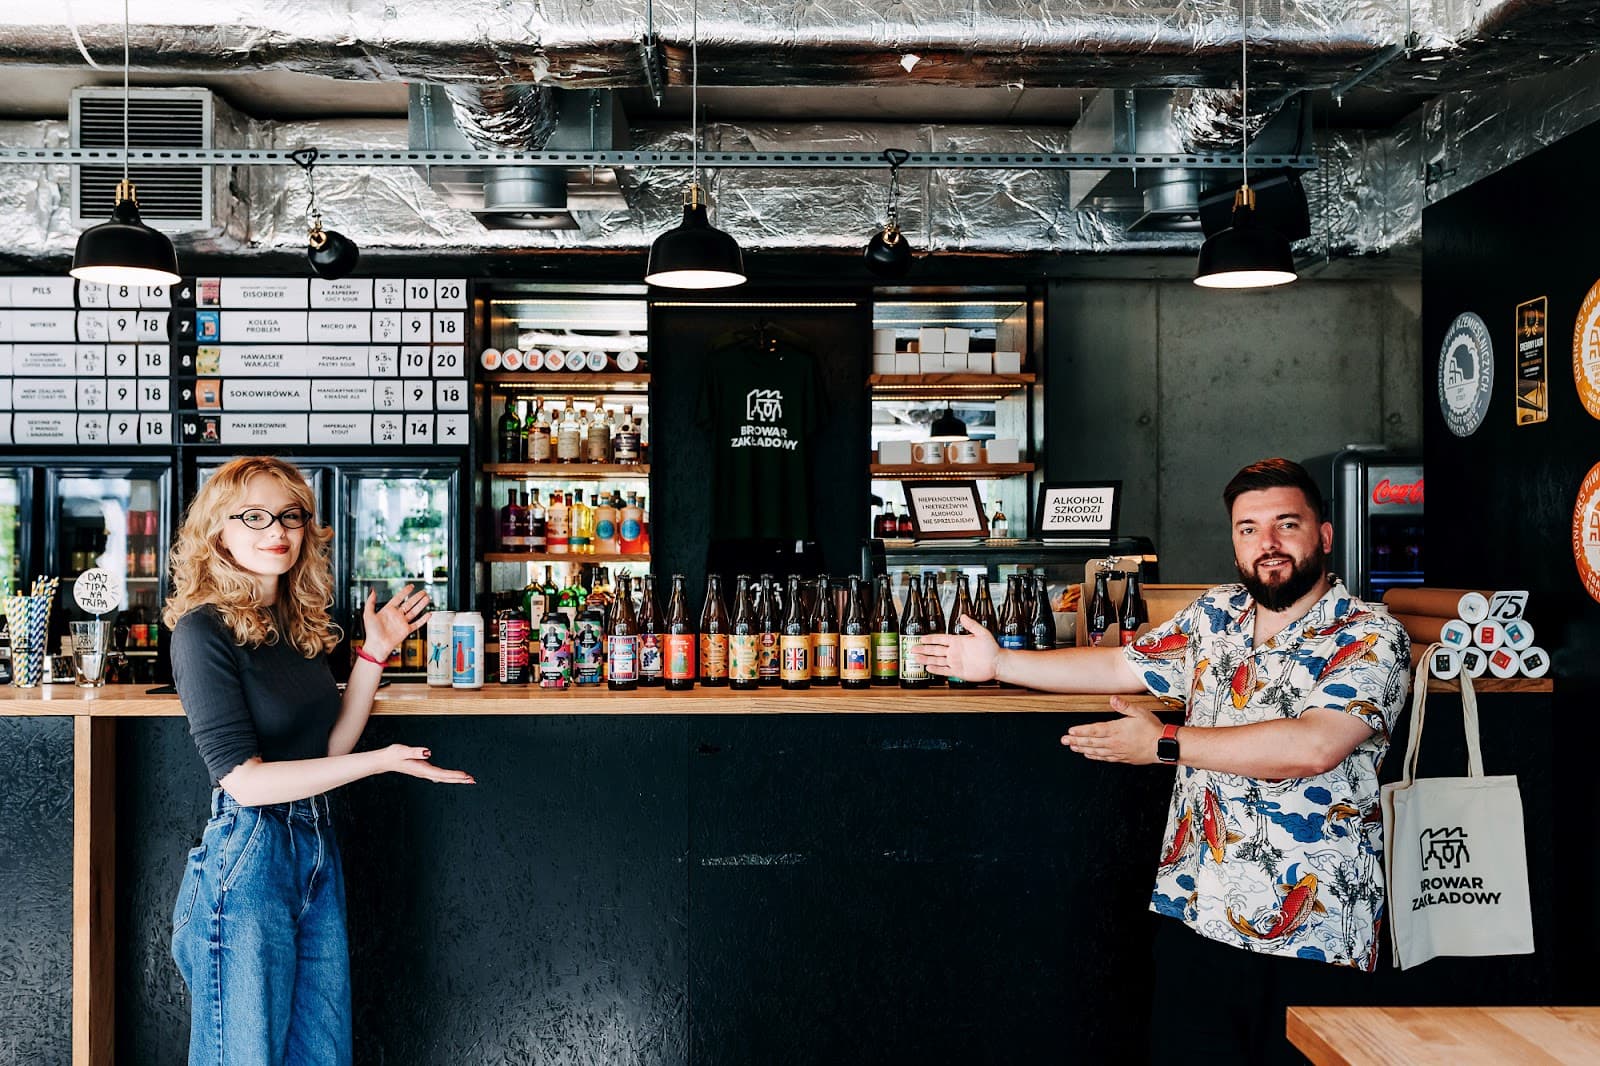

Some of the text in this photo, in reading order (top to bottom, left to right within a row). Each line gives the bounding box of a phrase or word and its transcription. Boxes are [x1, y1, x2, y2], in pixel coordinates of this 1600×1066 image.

[120, 285, 128, 297] 8
[146, 286, 163, 296] 16
[181, 288, 190, 299] 6
[411, 286, 428, 299] 10
[441, 286, 460, 299] 20
[1583, 286, 1598, 312] PIW
[117, 318, 126, 331] 9
[144, 319, 158, 332] 18
[180, 320, 190, 332] 7
[412, 320, 421, 333] 9
[440, 320, 456, 333] 18
[117, 354, 126, 366] 9
[145, 353, 161, 366] 18
[182, 355, 191, 367] 8
[407, 354, 423, 367] 10
[437, 354, 456, 367] 20
[118, 388, 127, 400] 9
[145, 388, 161, 400] 18
[182, 389, 191, 400] 9
[414, 389, 423, 401] 9
[443, 389, 459, 402] 18
[119, 422, 128, 435] 9
[147, 422, 162, 435] 18
[184, 423, 196, 435] 10
[411, 423, 427, 436] 14
[741, 425, 788, 438] BROWAR
[731, 436, 798, 450] ZAKŁADOWY
[1052, 496, 1104, 505] ALKOHOL
[1055, 505, 1100, 514] SZKODZI
[1573, 467, 1599, 560] KONKURS PIW
[1050, 514, 1103, 523] ZDROWIU
[88, 573, 108, 583] DAJ
[85, 582, 108, 591] TIPA
[80, 598, 108, 608] TRIPA
[1492, 596, 1523, 619] 75
